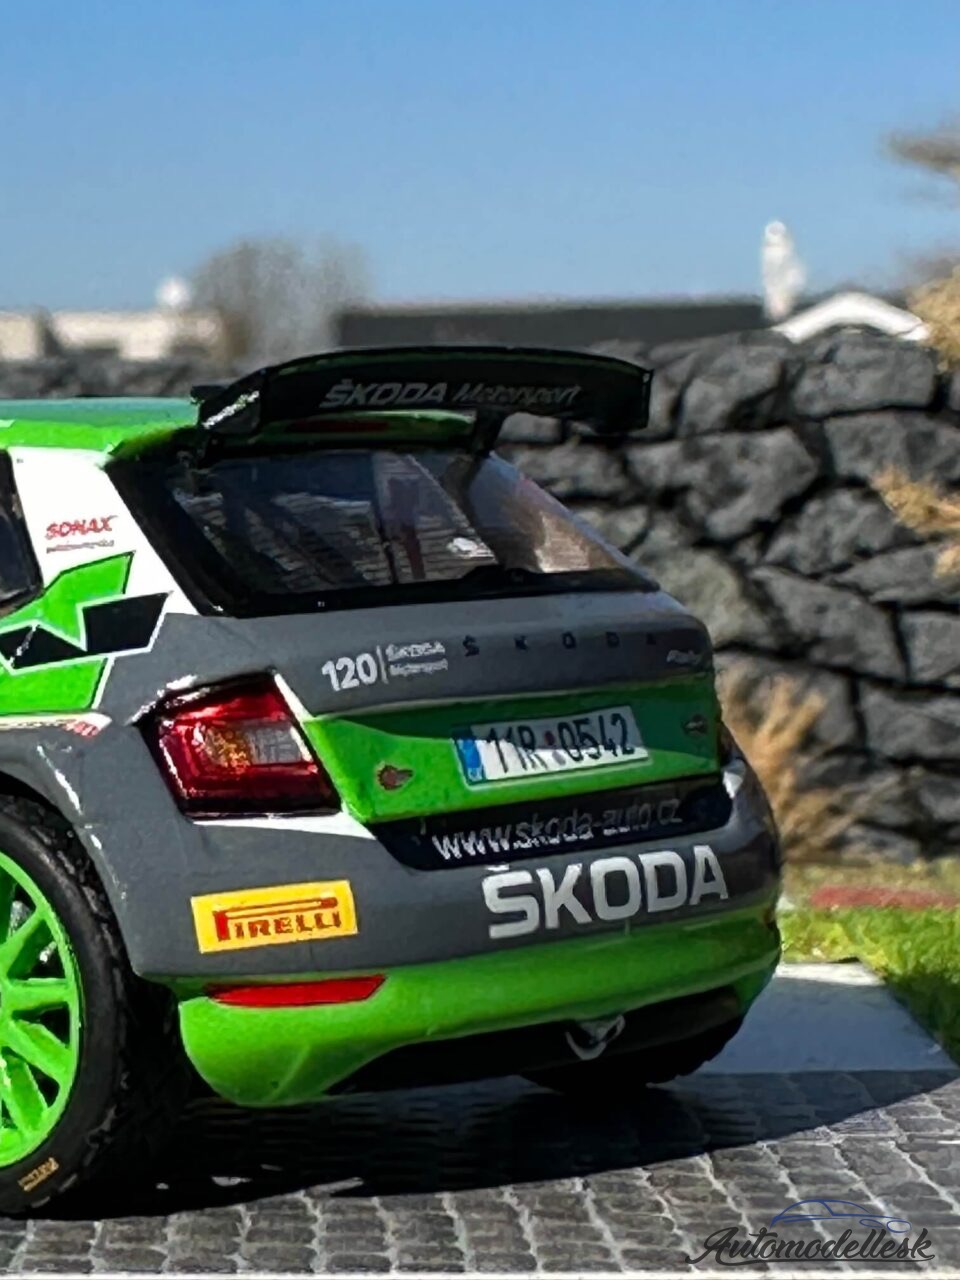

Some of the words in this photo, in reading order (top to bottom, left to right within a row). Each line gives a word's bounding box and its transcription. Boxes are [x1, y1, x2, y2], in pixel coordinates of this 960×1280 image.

[321, 657, 377, 692] 120
[558, 712, 635, 763] 0542
[481, 844, 729, 939] ŠKODA
[212, 897, 342, 942] PIRELLI
